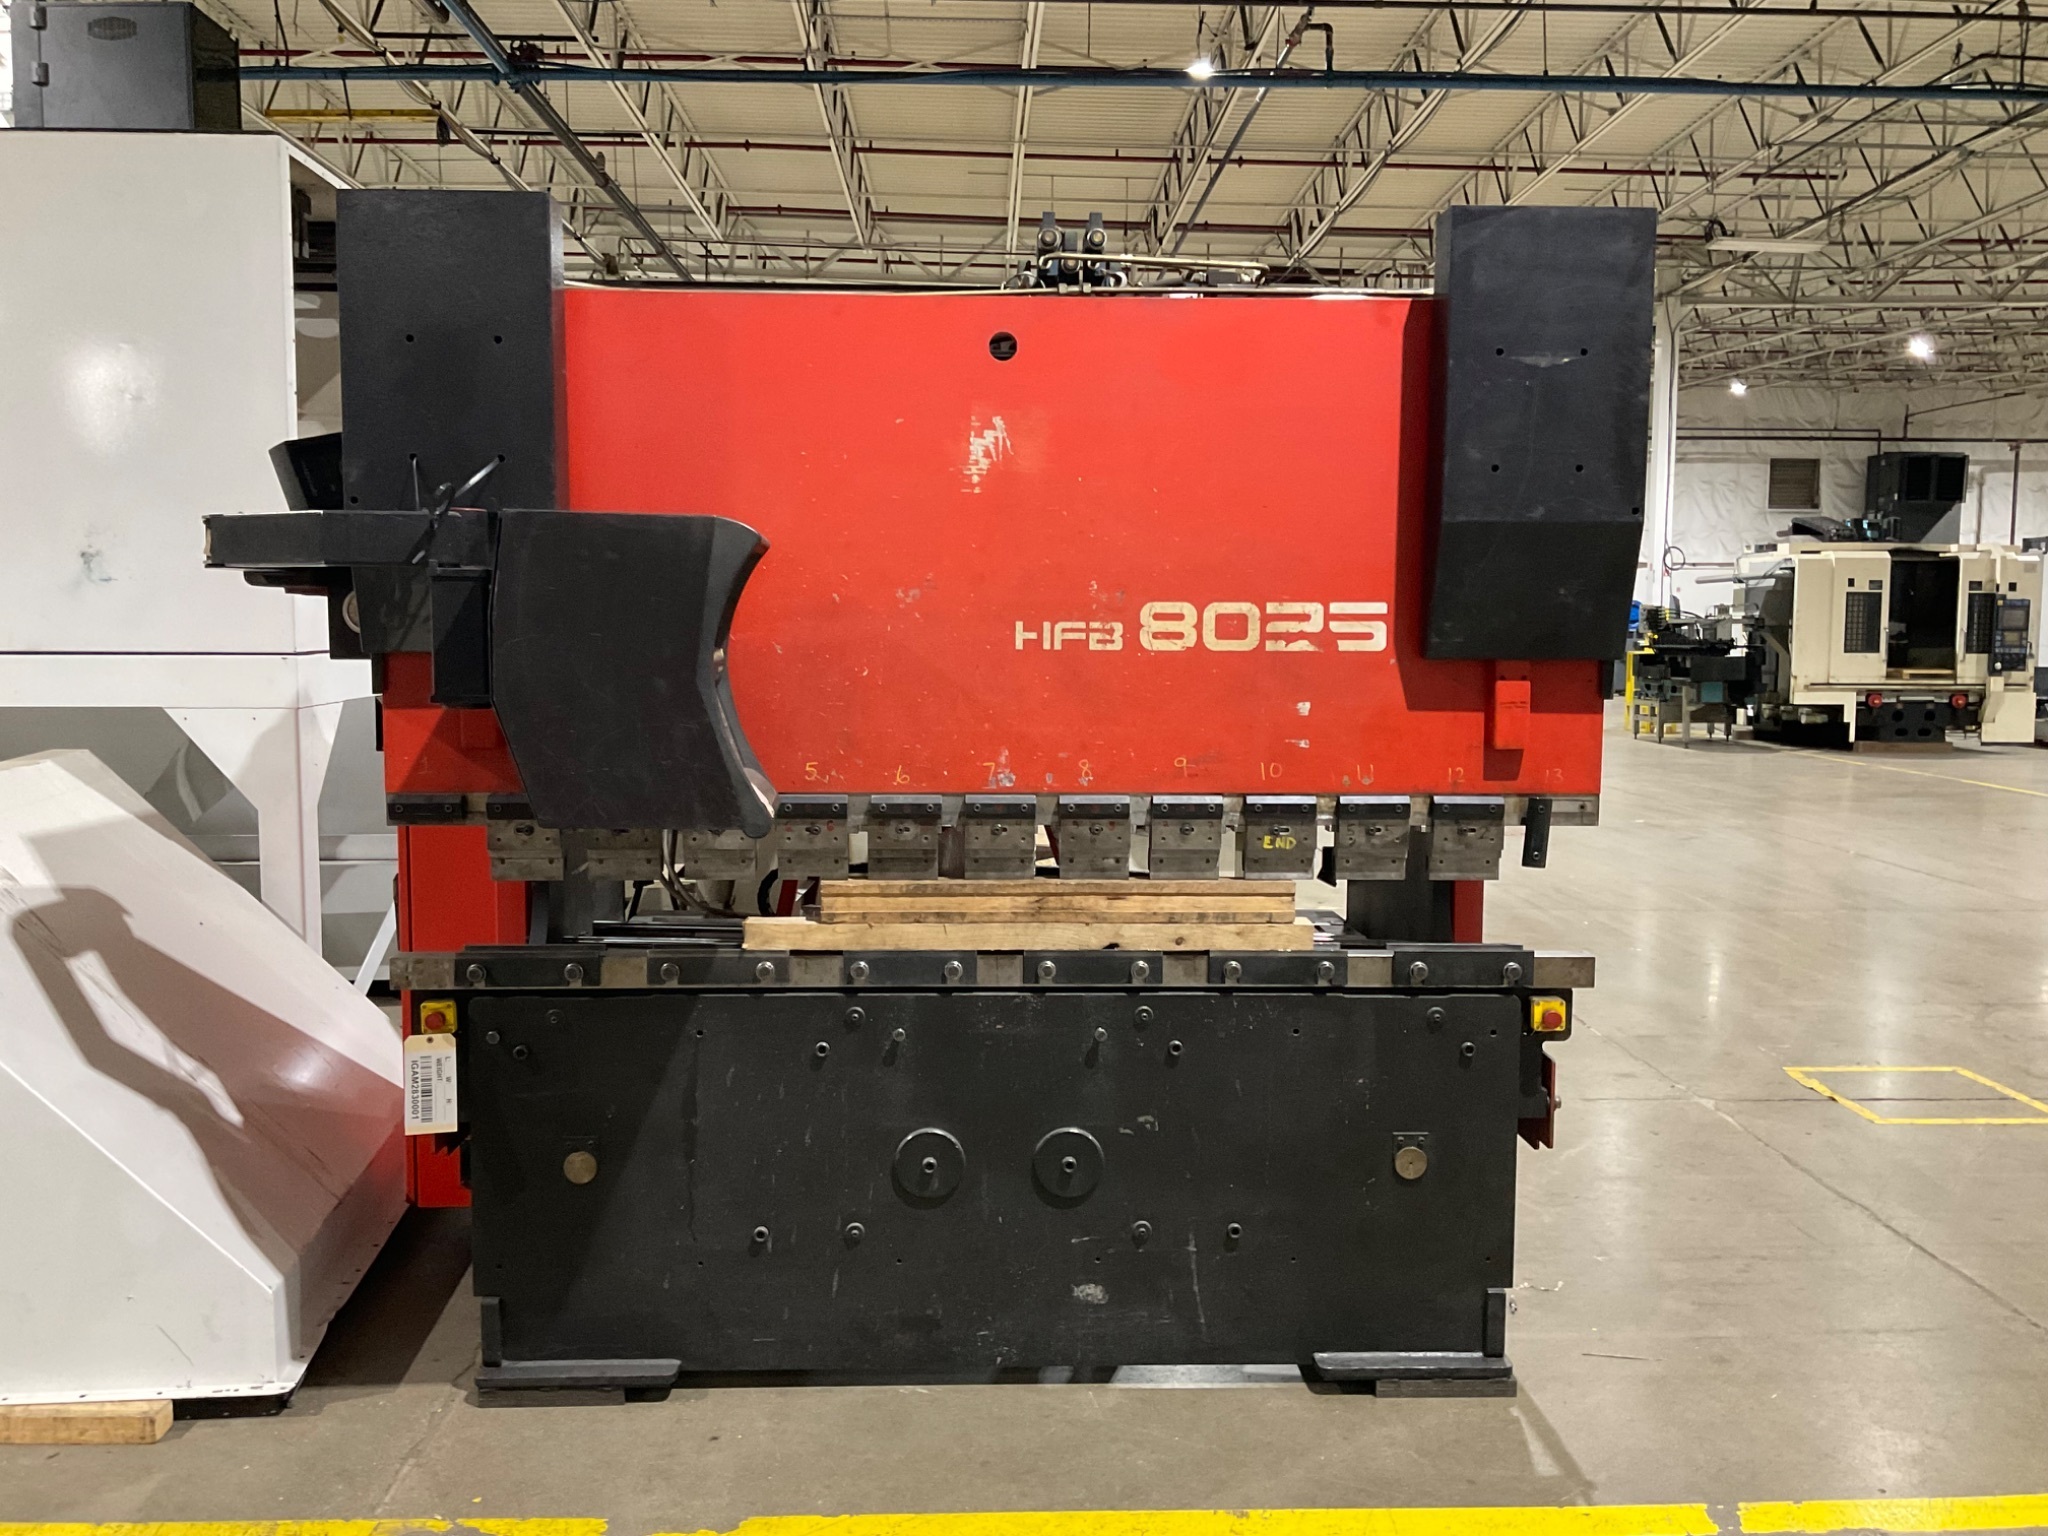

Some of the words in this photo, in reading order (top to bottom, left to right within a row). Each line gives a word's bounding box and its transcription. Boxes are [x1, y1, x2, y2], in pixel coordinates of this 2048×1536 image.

[1015, 621, 1123, 650] HFB
[1139, 602, 1388, 652] 8025
[804, 761, 819, 781] 5
[895, 764, 910, 784] 6
[982, 761, 996, 781] 7
[1078, 759, 1092, 779] 8
[1173, 757, 1187, 778] 9
[1260, 762, 1283, 781] 10
[1447, 767, 1465, 783] 12
[1545, 768, 1564, 784] 13
[1262, 835, 1297, 850] END
